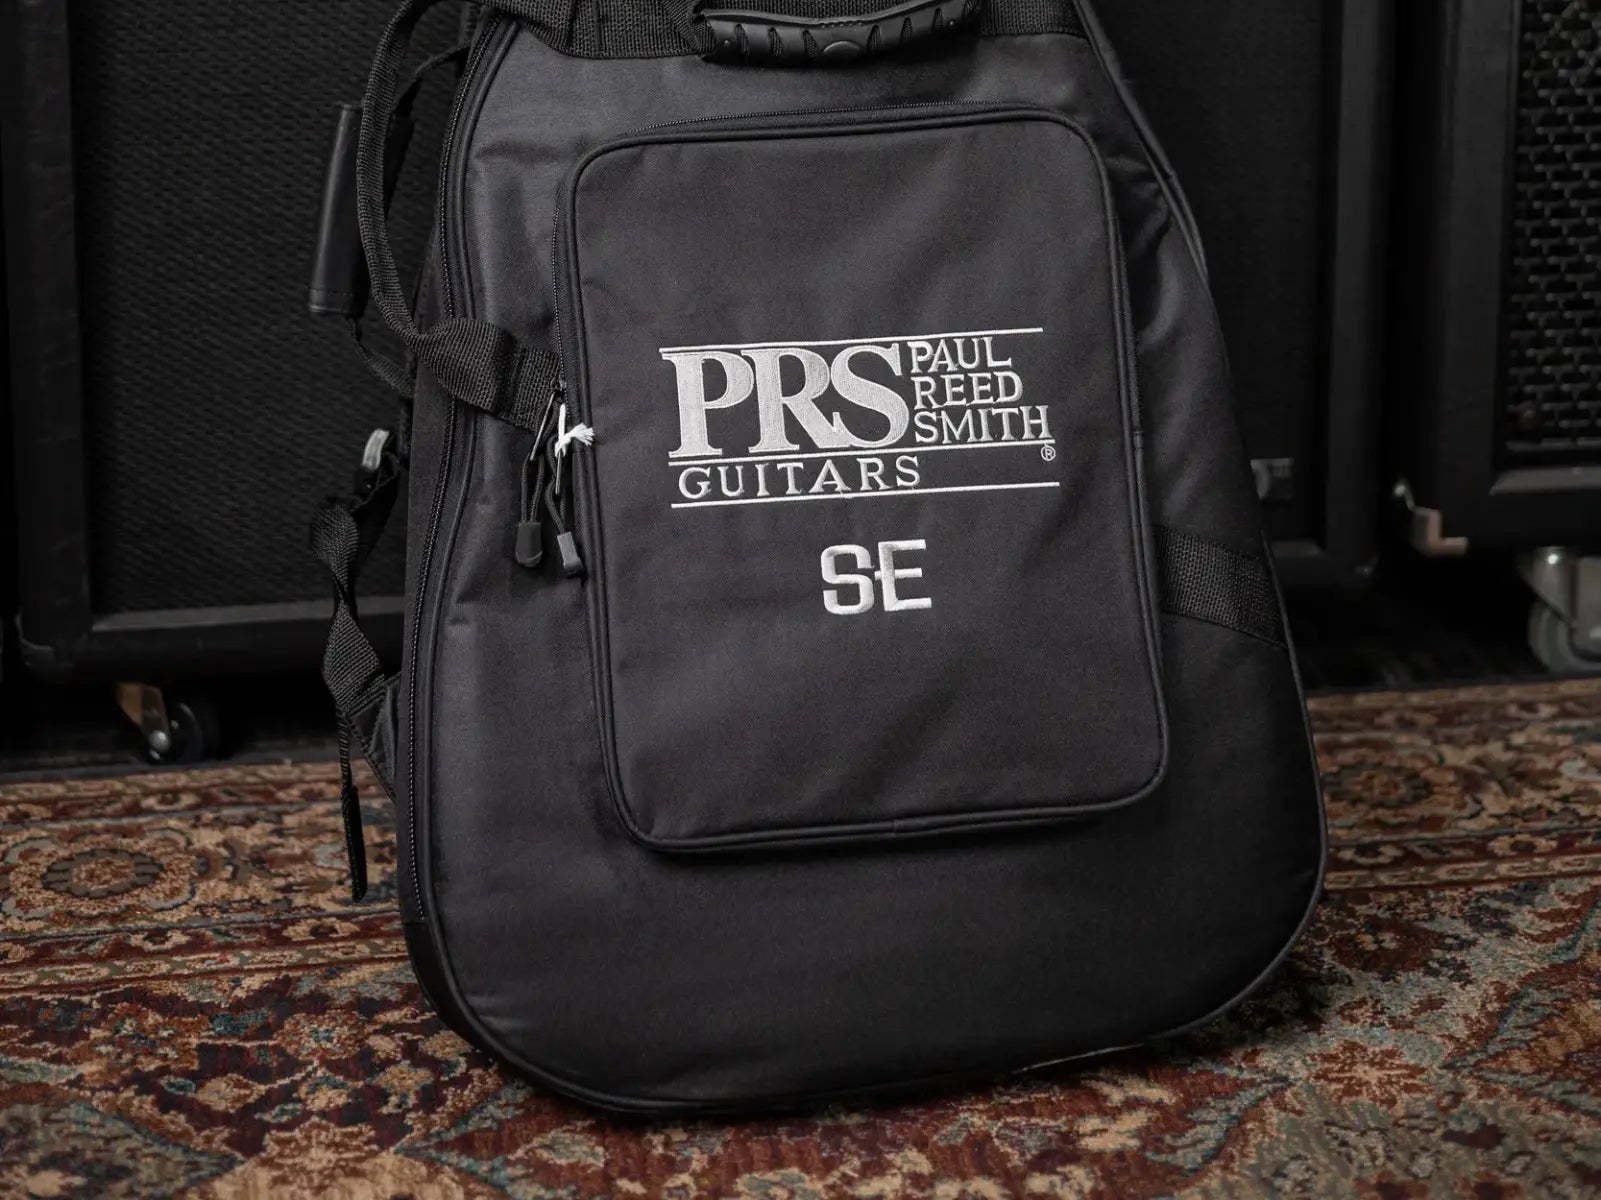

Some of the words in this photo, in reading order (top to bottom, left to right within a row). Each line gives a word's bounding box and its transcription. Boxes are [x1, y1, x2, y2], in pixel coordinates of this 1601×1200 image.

[907, 337, 1013, 373] PAUL
[661, 343, 910, 458] PRS
[911, 371, 1024, 410] REED
[914, 405, 1053, 444] SMITH
[678, 455, 921, 499] GUITARS
[820, 539, 932, 615] SE
